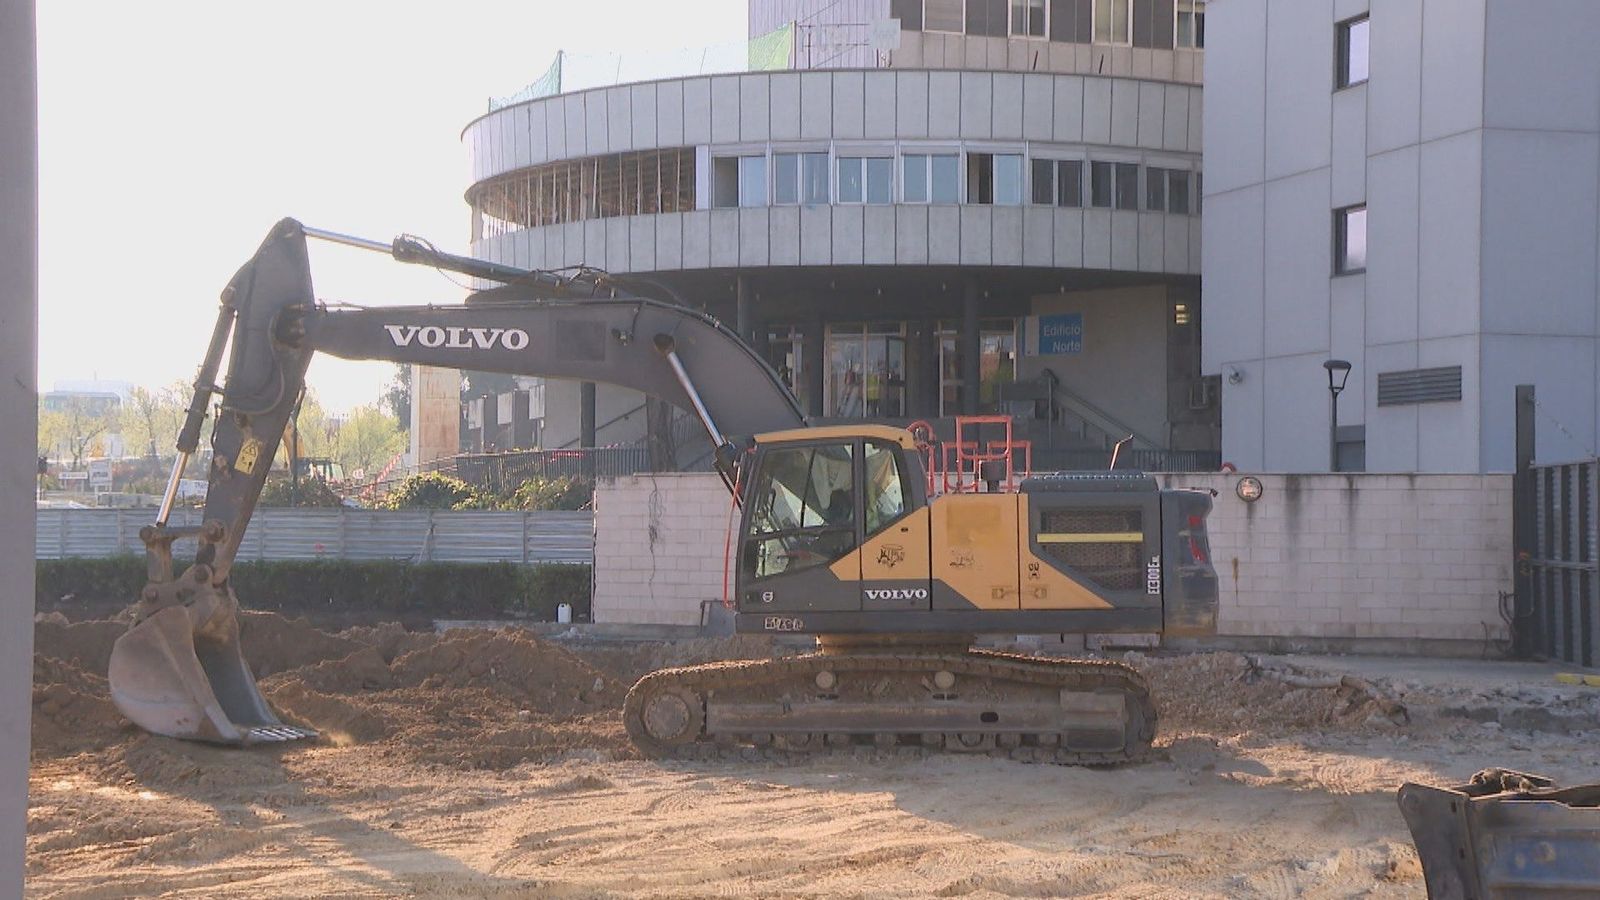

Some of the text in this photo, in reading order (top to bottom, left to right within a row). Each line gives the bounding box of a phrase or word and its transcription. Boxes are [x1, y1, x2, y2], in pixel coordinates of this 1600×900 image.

[384, 324, 529, 350] VOLVO
[1043, 324, 1081, 337] Edificio
[1052, 340, 1081, 353] Norte
[864, 589, 928, 601] VOLVO
